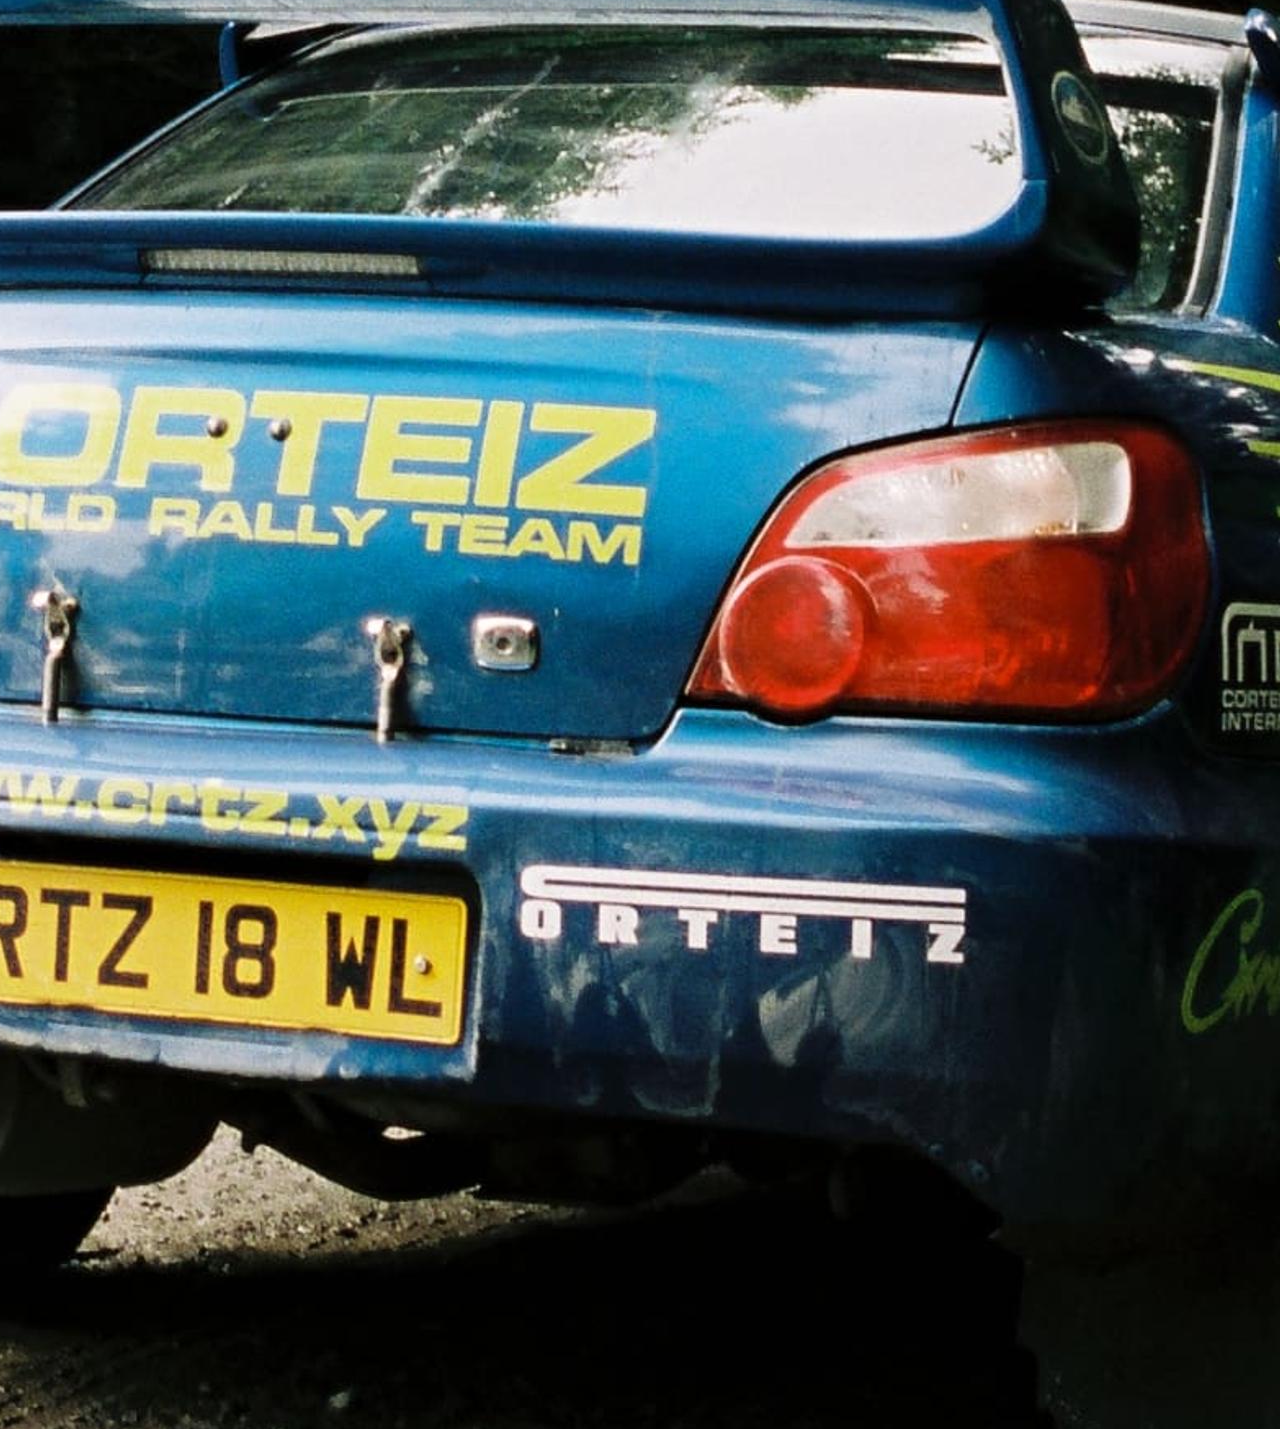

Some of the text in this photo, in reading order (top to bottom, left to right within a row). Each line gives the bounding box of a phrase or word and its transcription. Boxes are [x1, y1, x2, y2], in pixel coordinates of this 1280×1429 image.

[148, 497, 387, 547] RALLY
[412, 511, 643, 566] TEAM
[193, 900, 279, 1000] 18
[326, 911, 443, 1019] WL
